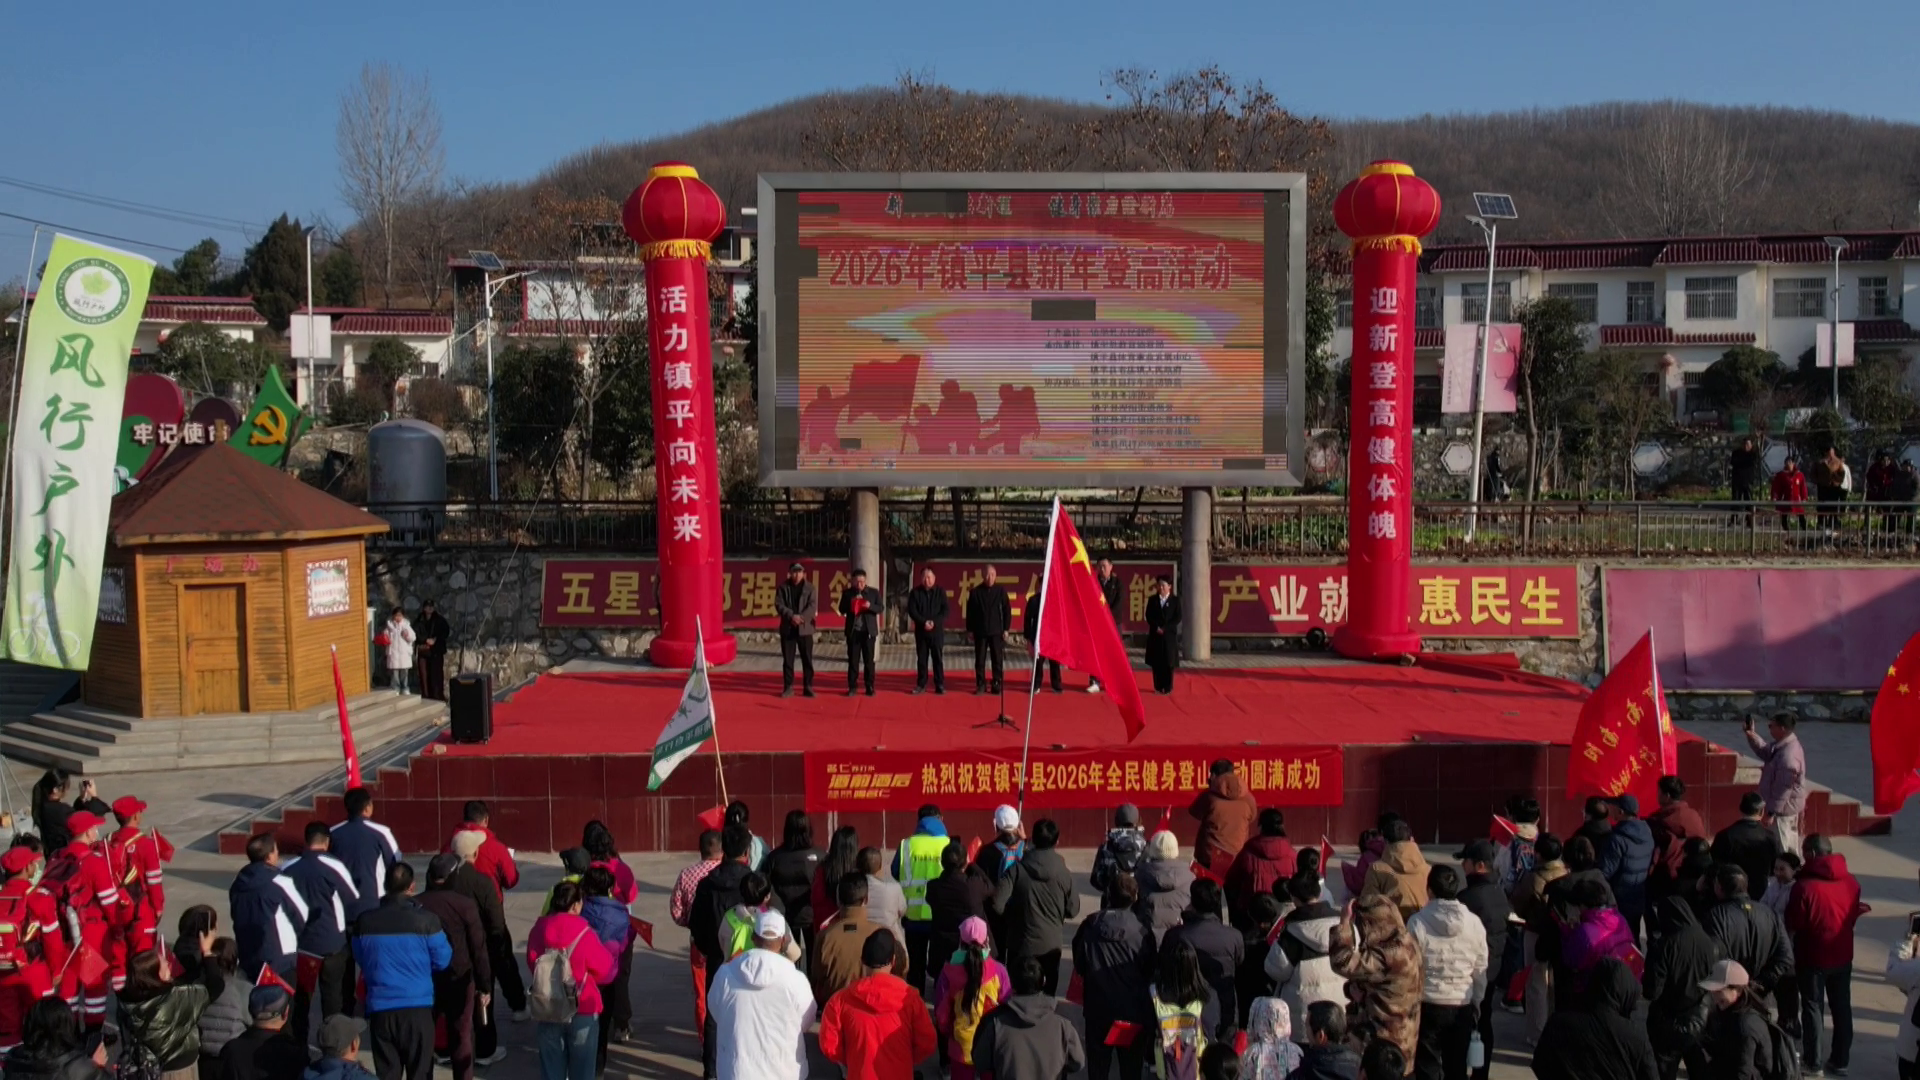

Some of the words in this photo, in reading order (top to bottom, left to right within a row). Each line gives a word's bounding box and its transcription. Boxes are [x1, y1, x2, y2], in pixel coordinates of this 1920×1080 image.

[829, 243, 1232, 293] 2026年镇平县新年登高活动
[660, 285, 702, 542] 活力镇平向未来
[1367, 286, 1399, 540] 迎新登高健体魄
[31, 332, 106, 667] 风行户外
[1217, 574, 1565, 626] 产业就惠民生
[920, 758, 1322, 796] 热烈祝贺镇平县2026年全民健身登山动圆满成功
